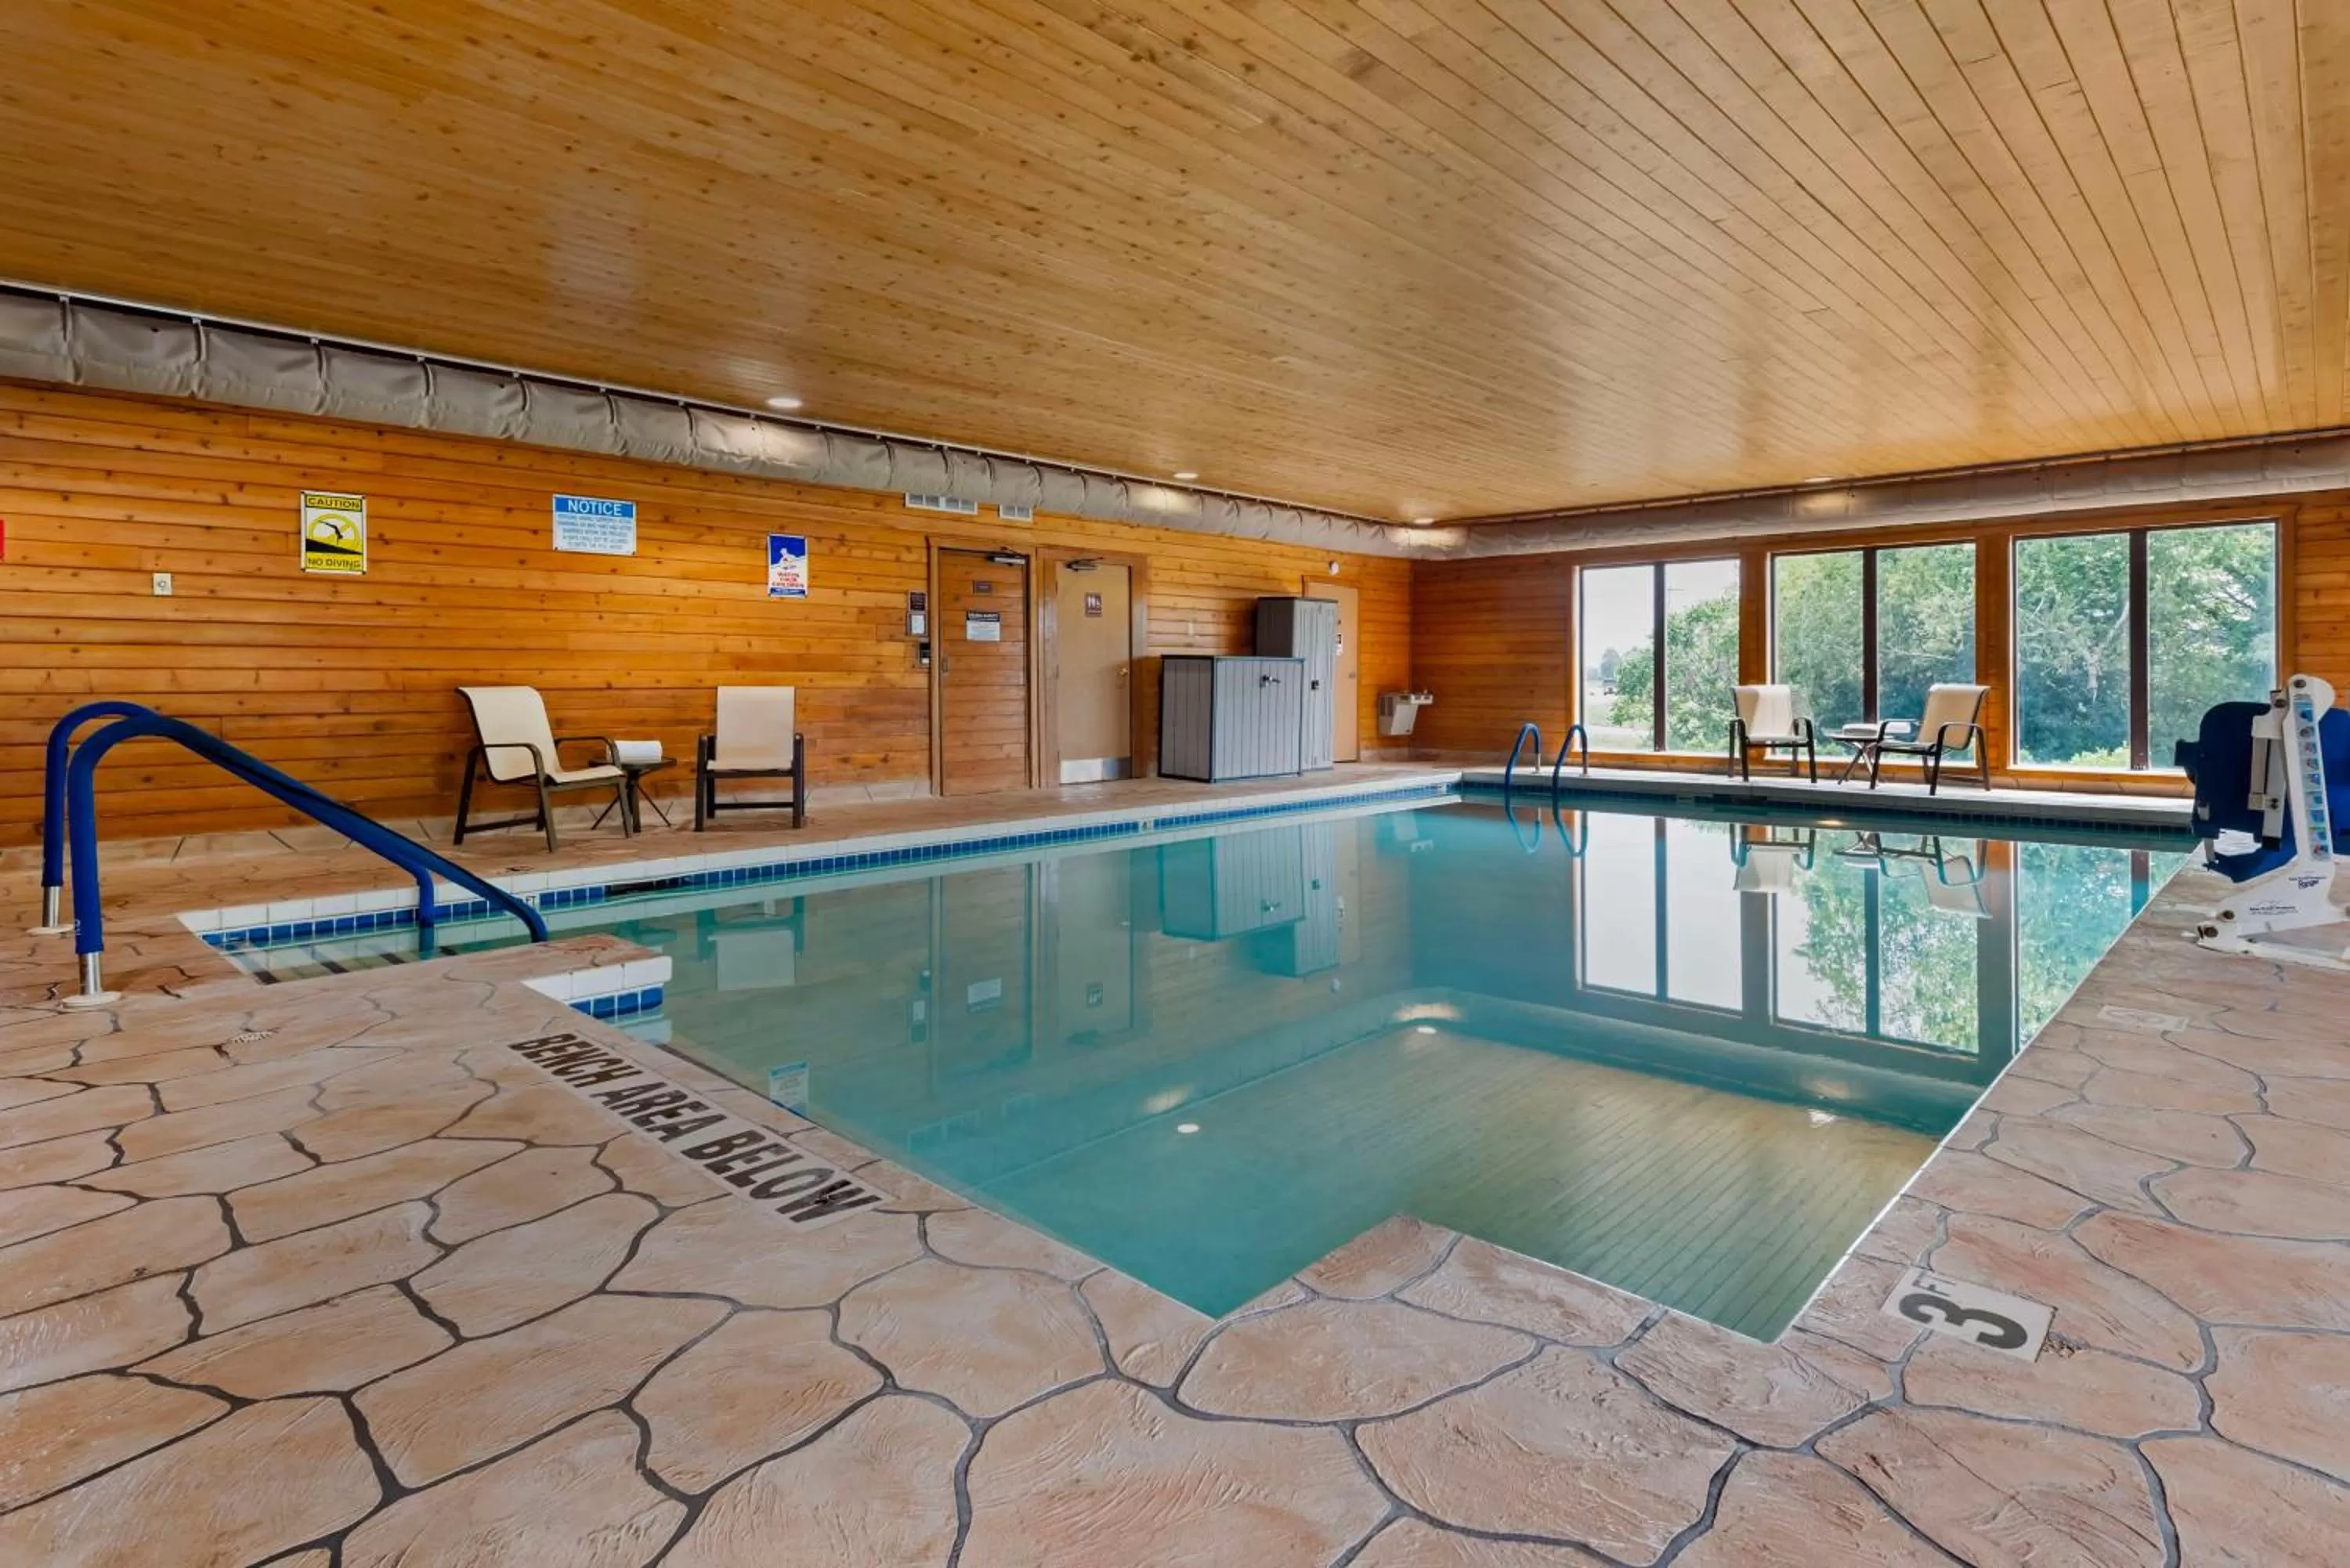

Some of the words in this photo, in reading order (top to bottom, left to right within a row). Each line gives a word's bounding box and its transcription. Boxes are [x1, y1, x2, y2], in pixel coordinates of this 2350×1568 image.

[308, 497, 360, 508] CAUTION
[568, 500, 622, 516] NOTICE
[325, 558, 360, 568] DIVING
[508, 1033, 644, 1089] BENCH
[589, 1082, 727, 1143] AREA
[680, 1129, 898, 1223] BELOW
[1899, 1293, 2027, 1349] 3
